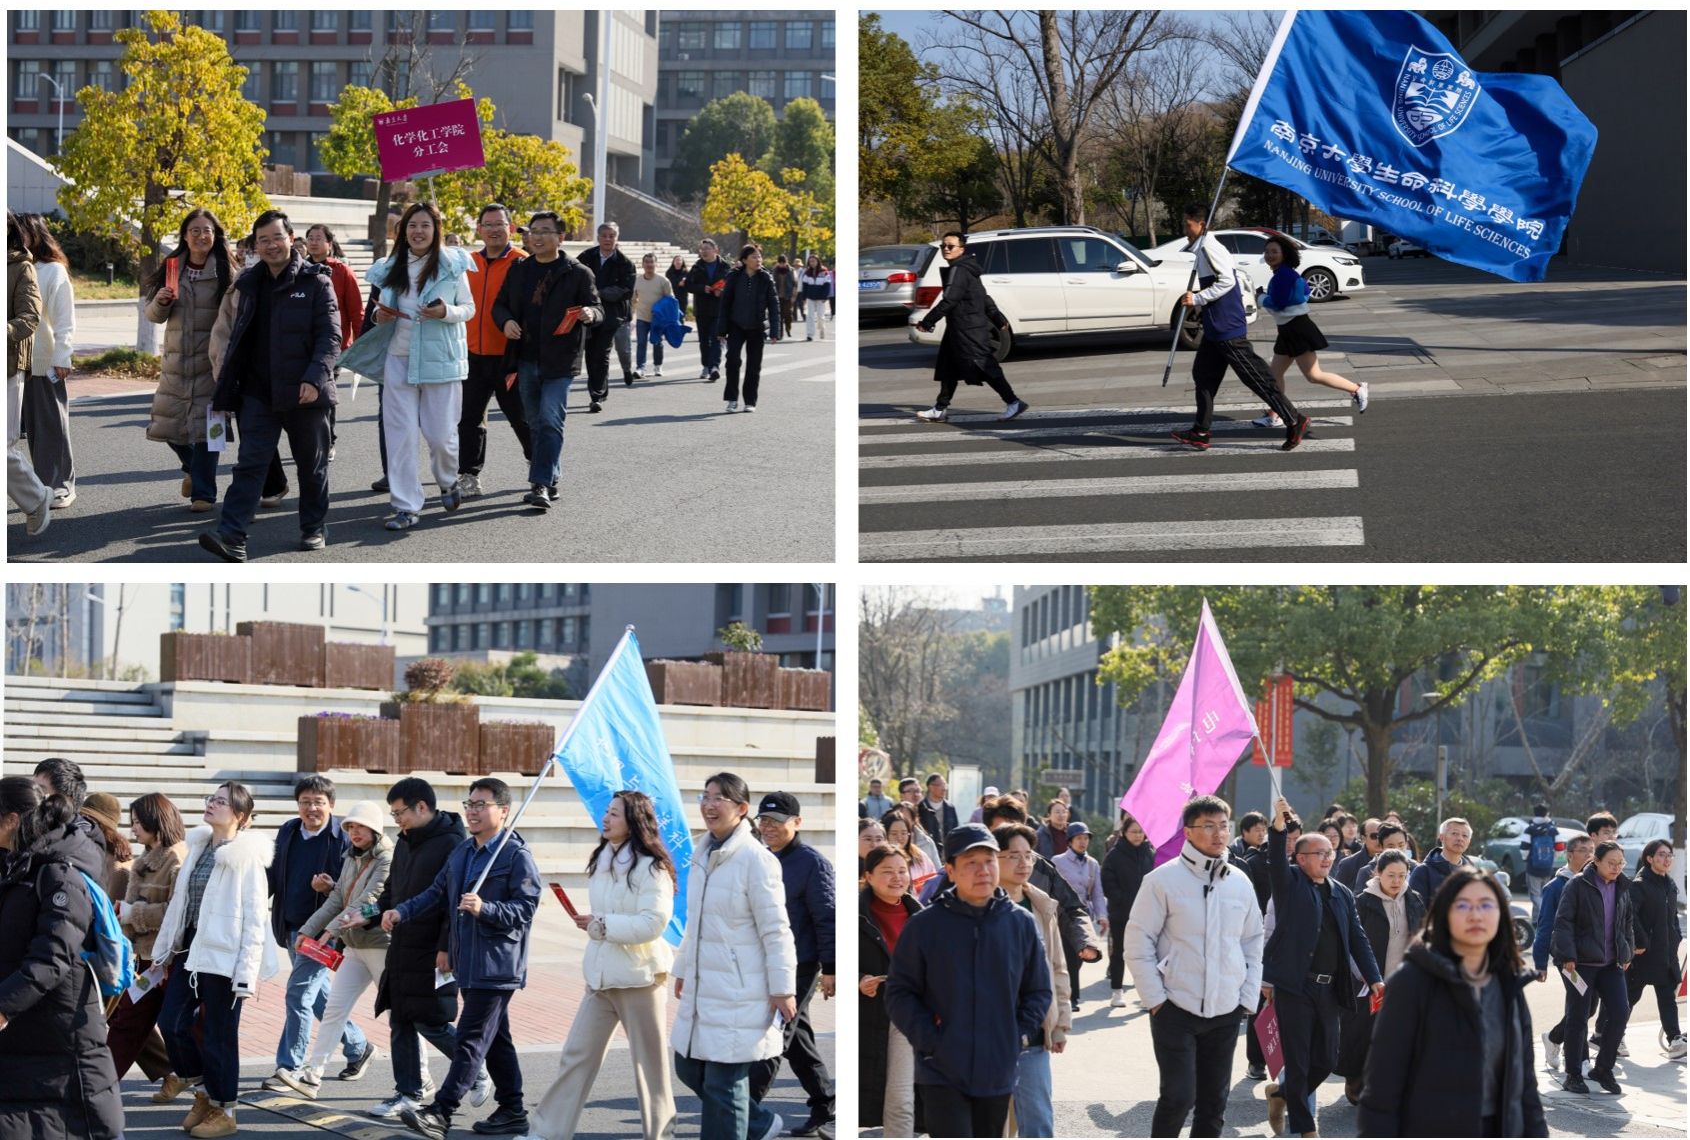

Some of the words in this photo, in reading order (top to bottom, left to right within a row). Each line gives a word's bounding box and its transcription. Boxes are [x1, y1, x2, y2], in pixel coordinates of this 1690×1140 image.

[392, 123, 466, 147] 化学化工学院
[412, 141, 450, 158] 分工会
[1263, 139, 1313, 176] NANJING
[1314, 166, 1381, 196] UNIVERSITY
[1377, 190, 1423, 213] SCHOOL
[1426, 204, 1444, 218] OF
[1444, 211, 1475, 233] LIFE
[1473, 224, 1532, 260] SCIENCES
